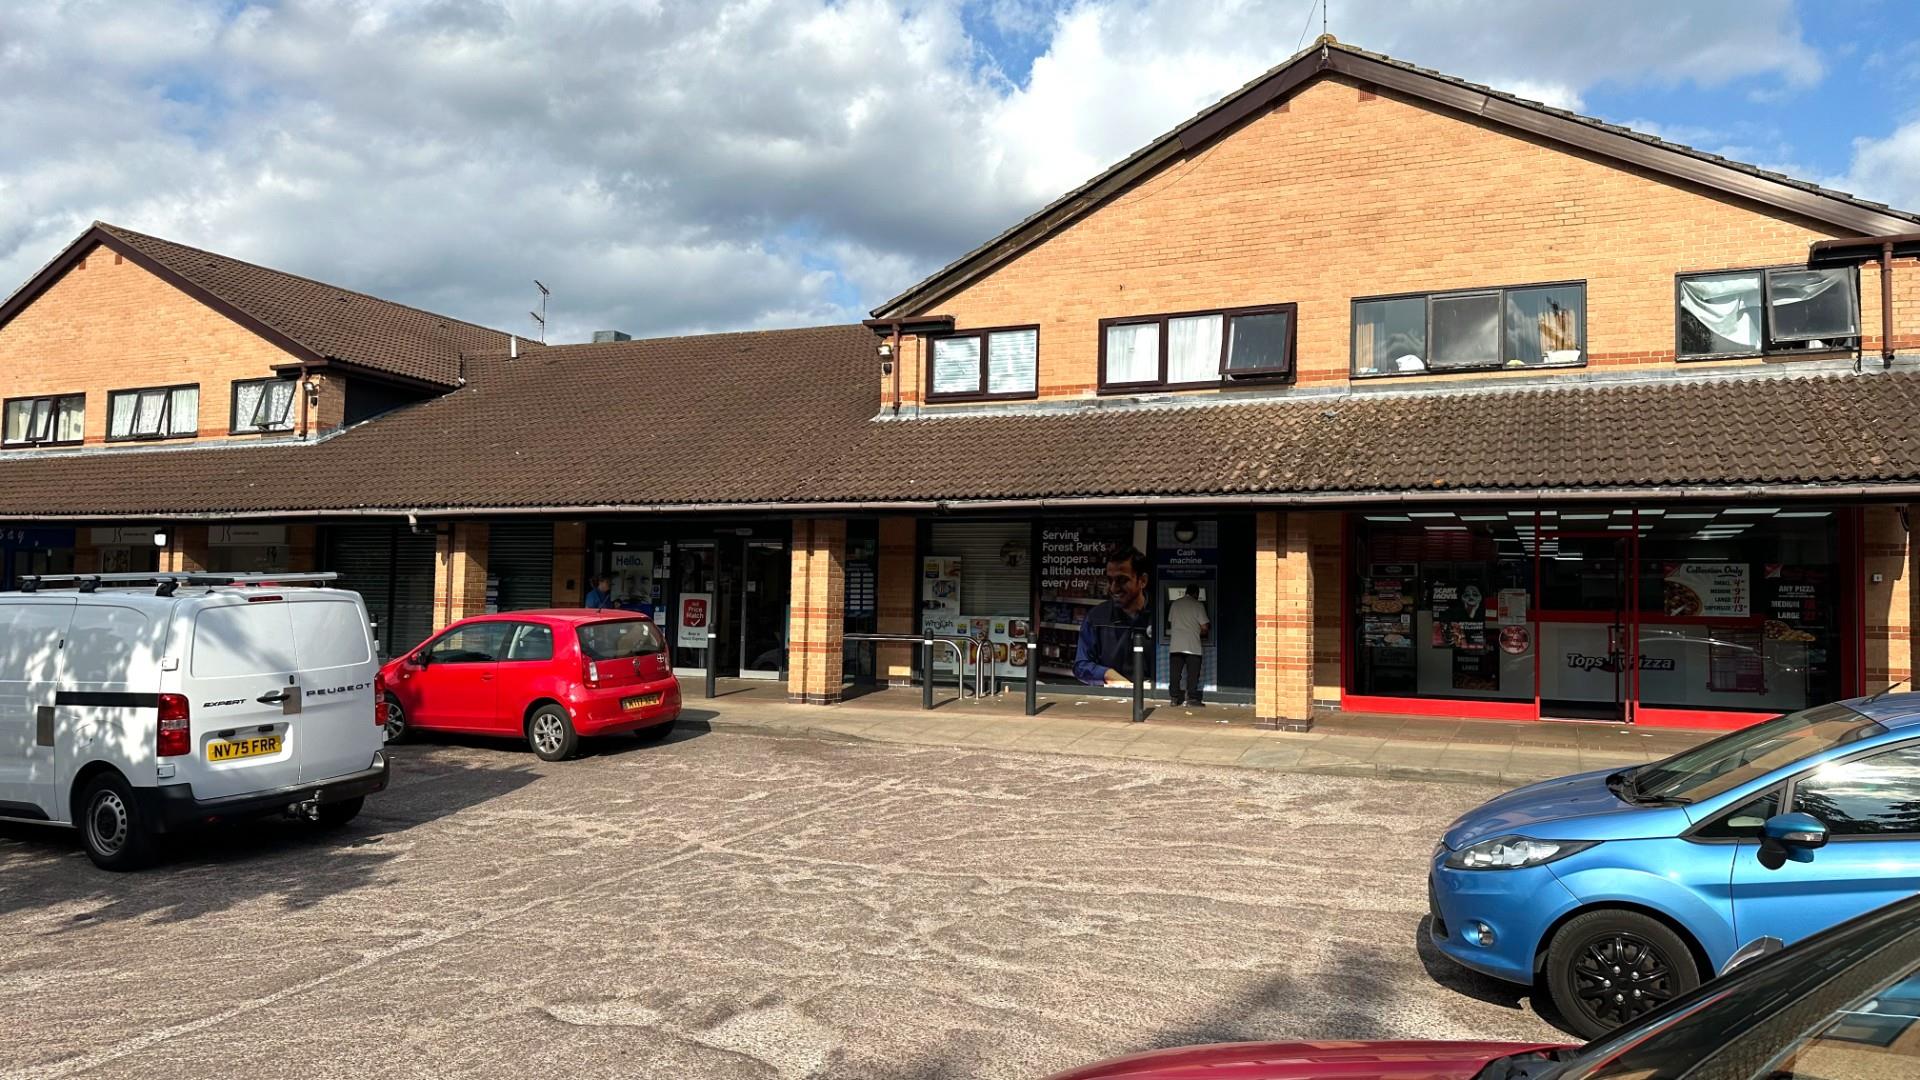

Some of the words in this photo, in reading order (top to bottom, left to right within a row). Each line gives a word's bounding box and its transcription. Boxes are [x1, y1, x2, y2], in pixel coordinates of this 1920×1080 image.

[1042, 530, 1080, 542] Serving
[1042, 542, 1073, 552] Forest
[1076, 541, 1106, 552] Park's
[1177, 548, 1197, 556] Cash
[616, 555, 644, 566] Hello.
[1042, 554, 1089, 566] shoppers
[1170, 556, 1202, 564] machine
[1042, 568, 1048, 576] a
[1049, 565, 1072, 576] little
[1073, 565, 1106, 576] better
[1686, 565, 1722, 574] Collection
[1724, 565, 1744, 577] Only
[1041, 579, 1070, 590] every
[1071, 577, 1089, 590] day
[1794, 585, 1816, 593] PIZZA
[1770, 600, 1800, 608] MEDIUM
[1777, 611, 1801, 619] LARGE
[1567, 654, 1604, 670] Tops
[306, 682, 372, 697] PEUGEOT
[203, 699, 247, 708] EXPERT
[214, 741, 249, 758] NV75
[251, 737, 276, 753] FRR
